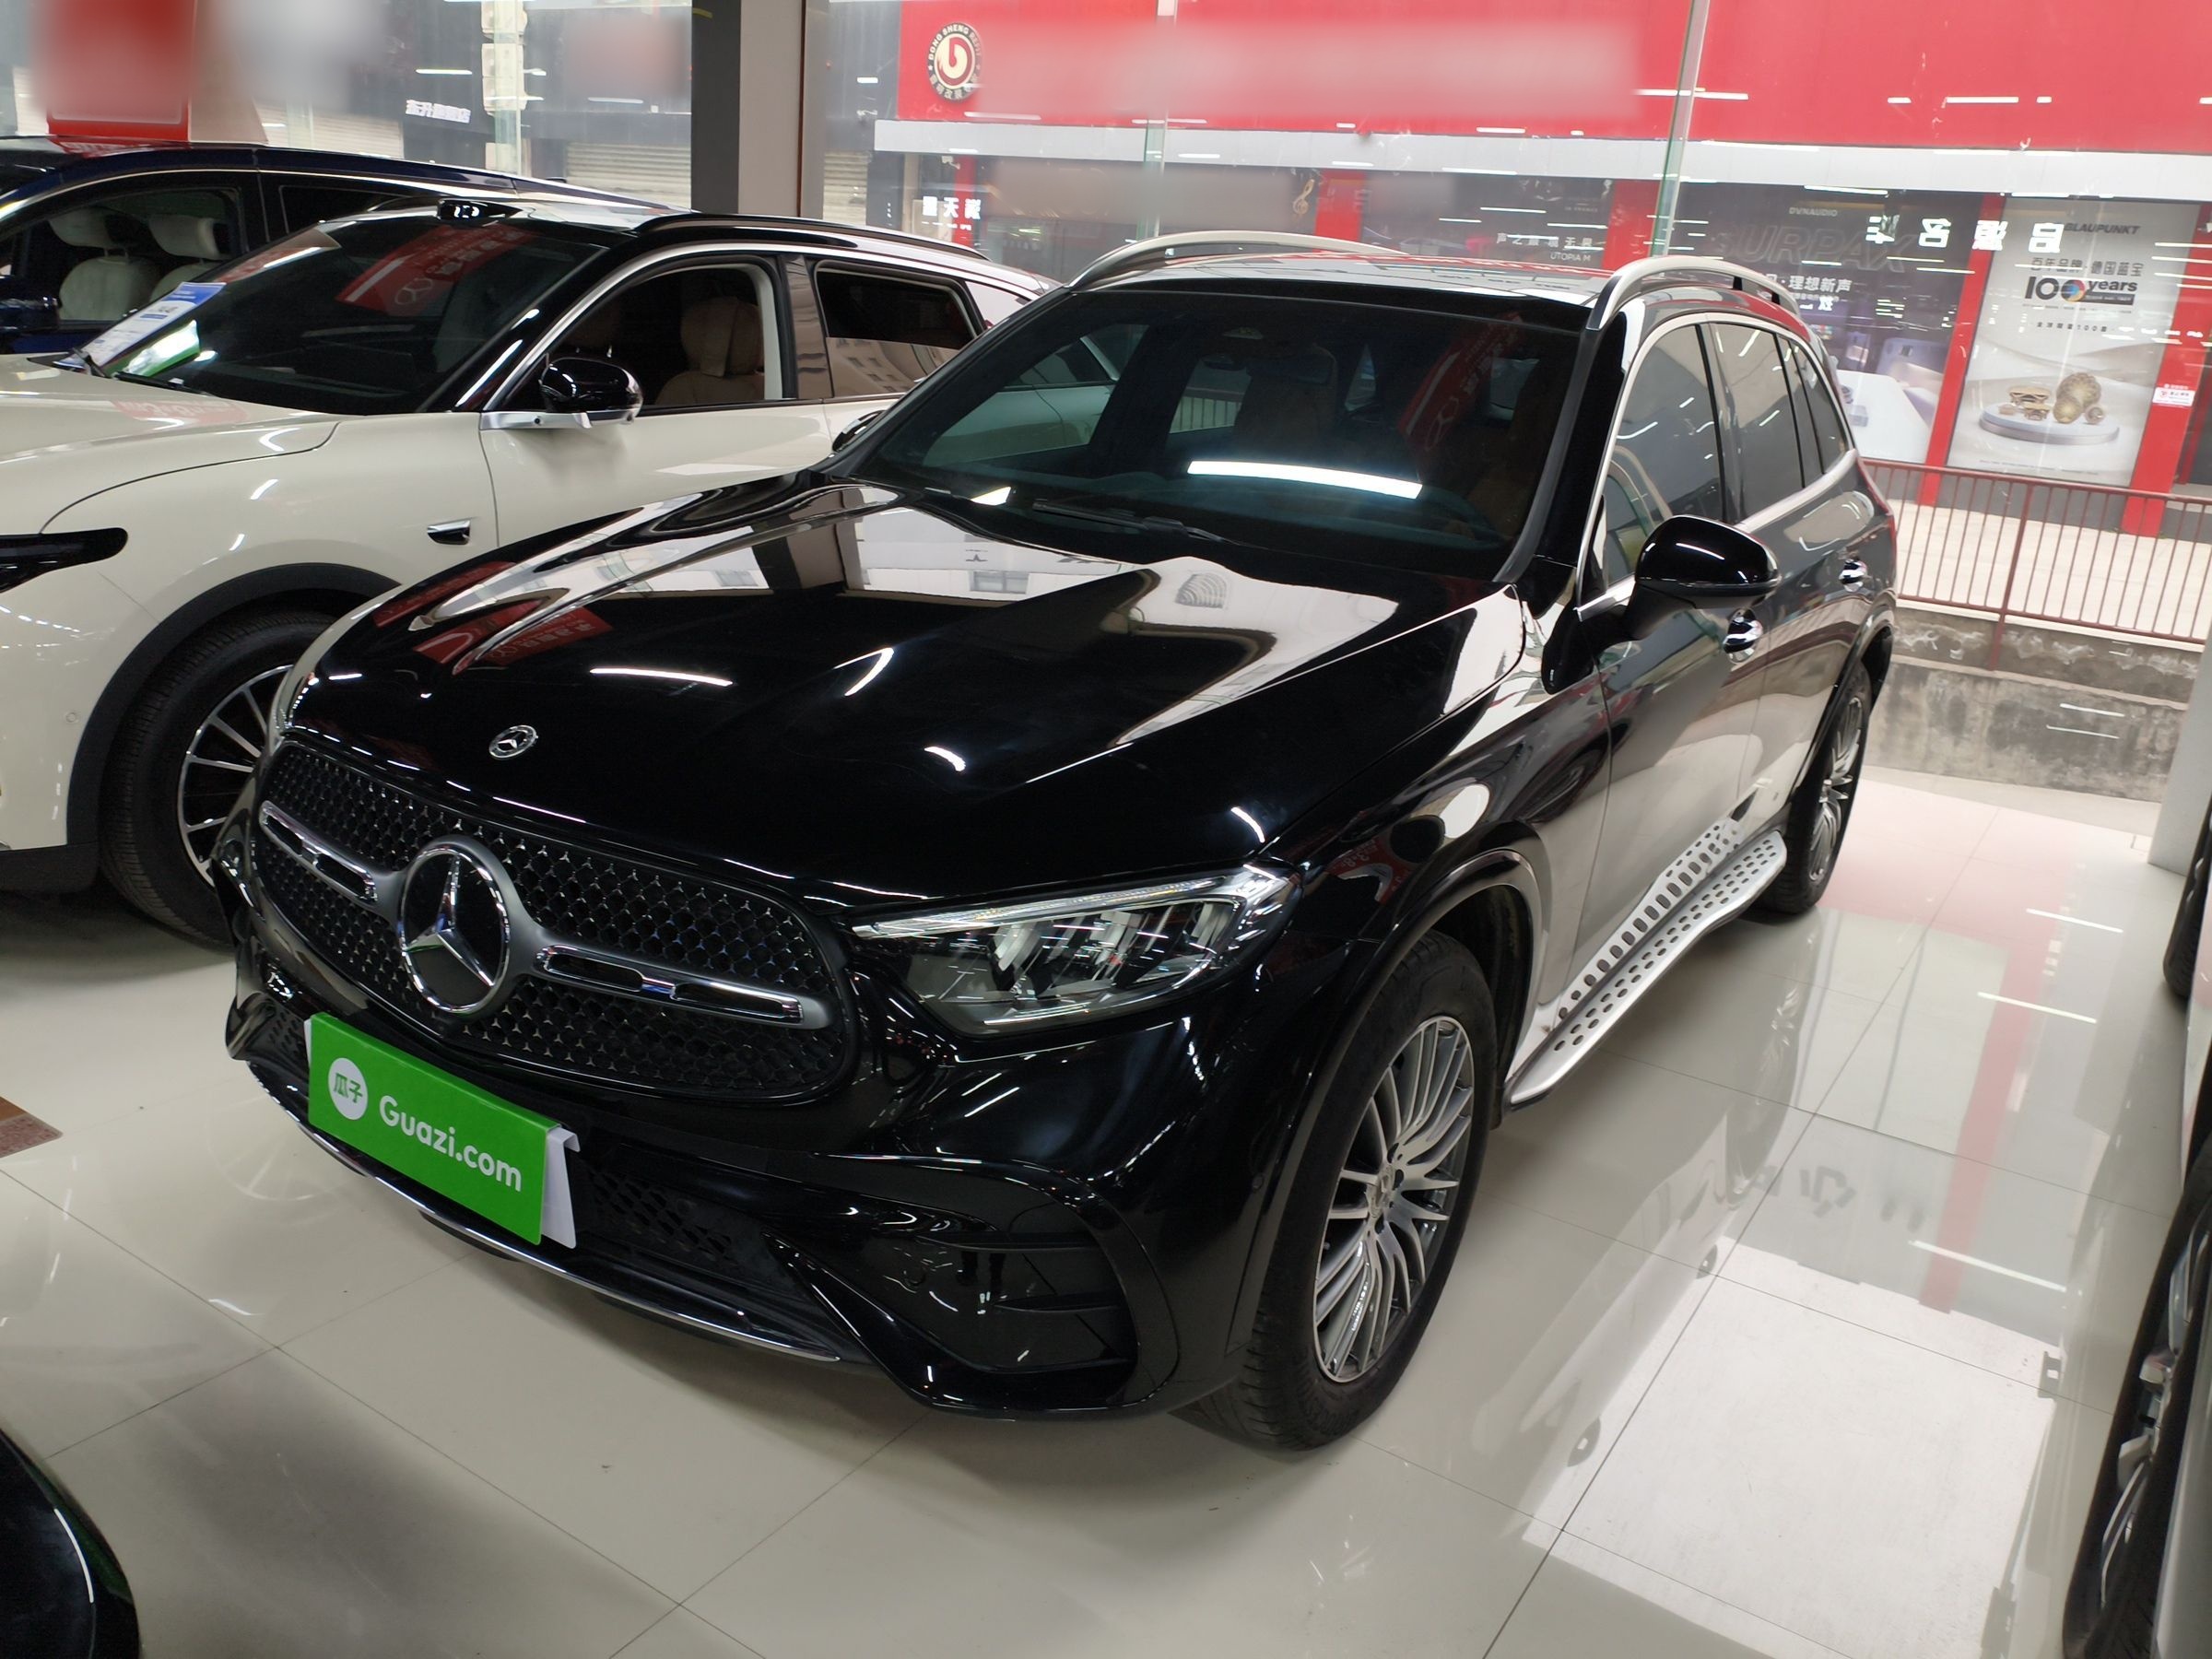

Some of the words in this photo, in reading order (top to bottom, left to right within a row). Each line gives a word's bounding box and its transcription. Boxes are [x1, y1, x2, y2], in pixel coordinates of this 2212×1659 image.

[2063, 222, 2141, 235] BLAUPUNKT
[2025, 276, 2086, 302] 100
[2087, 279, 2138, 294] years
[333, 1072, 363, 1103] 瓜子
[379, 1095, 522, 1193] Guazi.com
